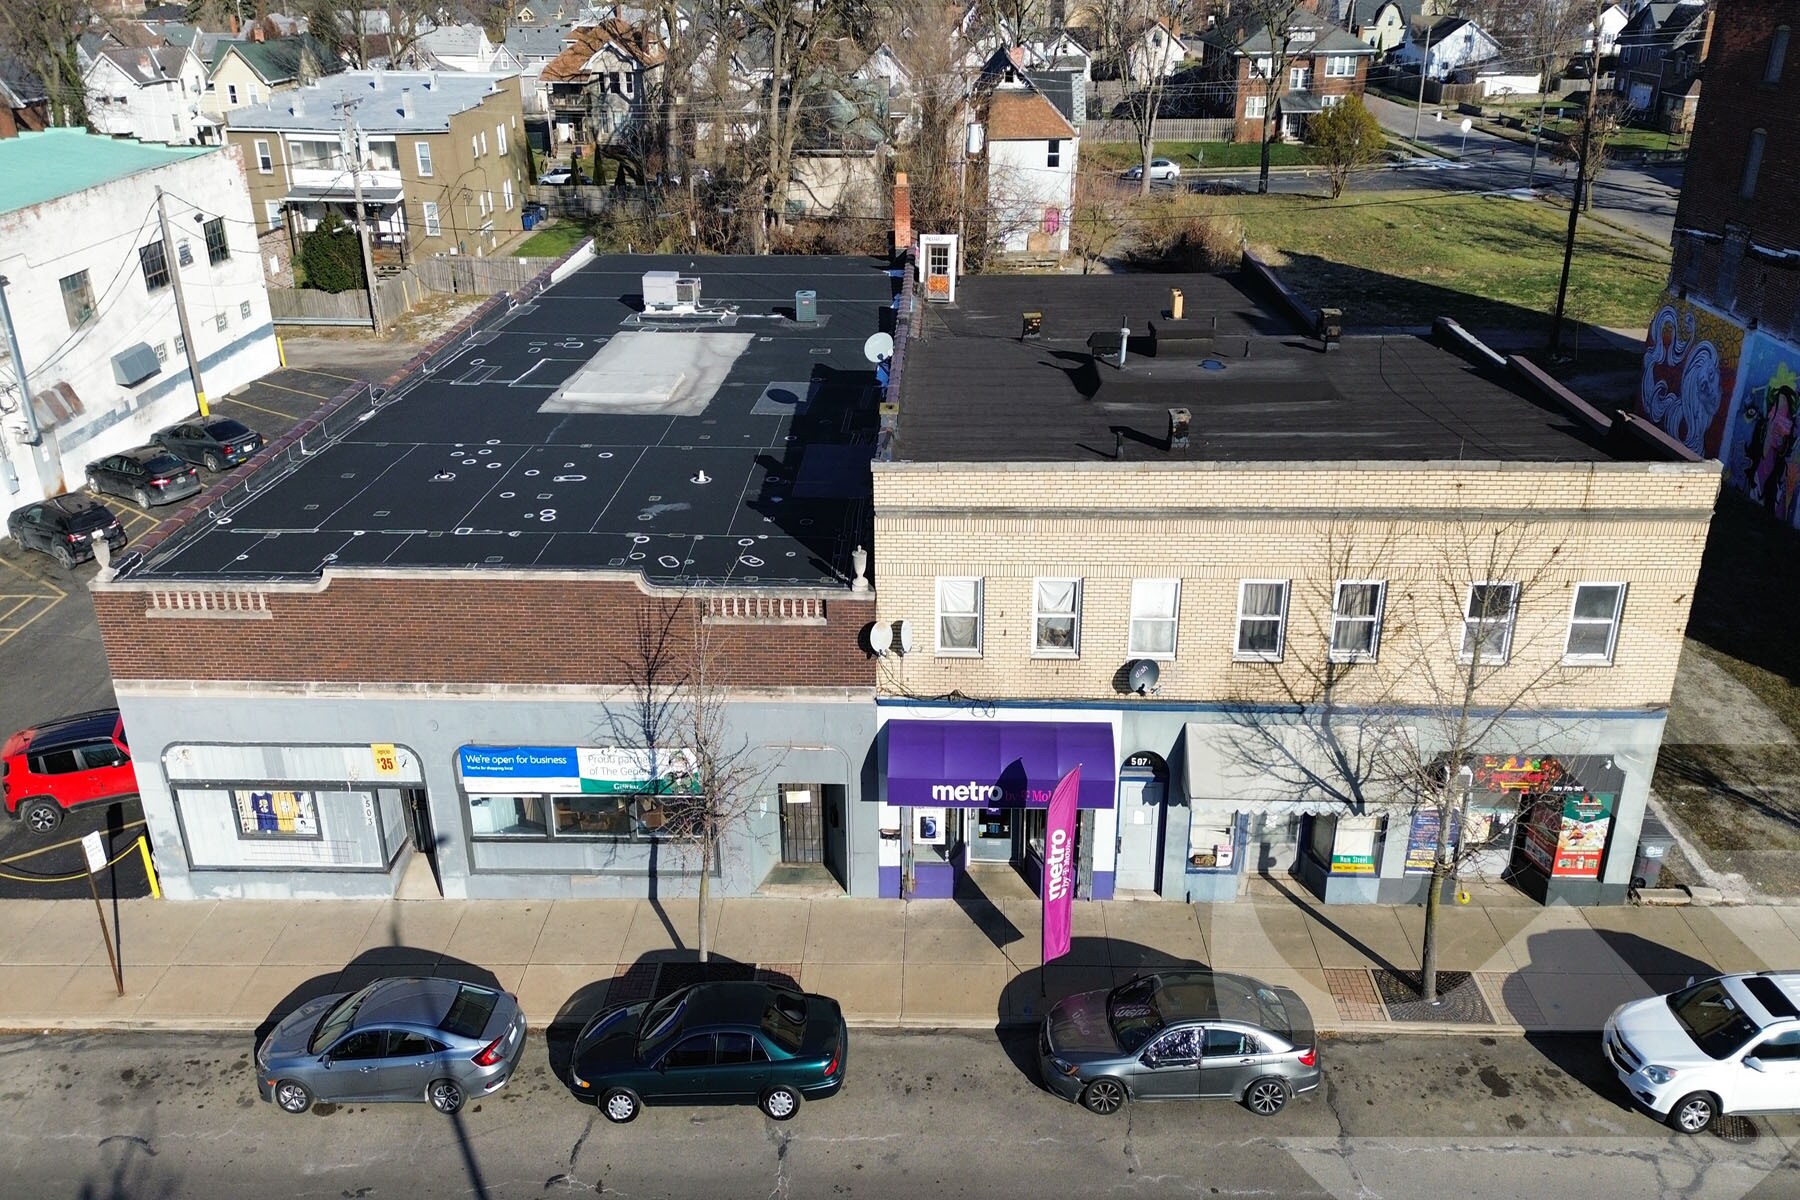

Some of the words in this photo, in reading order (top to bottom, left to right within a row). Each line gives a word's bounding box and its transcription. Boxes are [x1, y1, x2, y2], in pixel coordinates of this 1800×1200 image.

[1135, 665, 1149, 678] dish
[465, 754, 490, 764] We're
[492, 756, 514, 766] open
[516, 754, 528, 764] for
[530, 755, 567, 765] business
[589, 766, 599, 775] of
[600, 766, 618, 775] The
[932, 780, 1003, 801] metro
[1047, 828, 1067, 902] metro
[1352, 856, 1368, 864] Street
